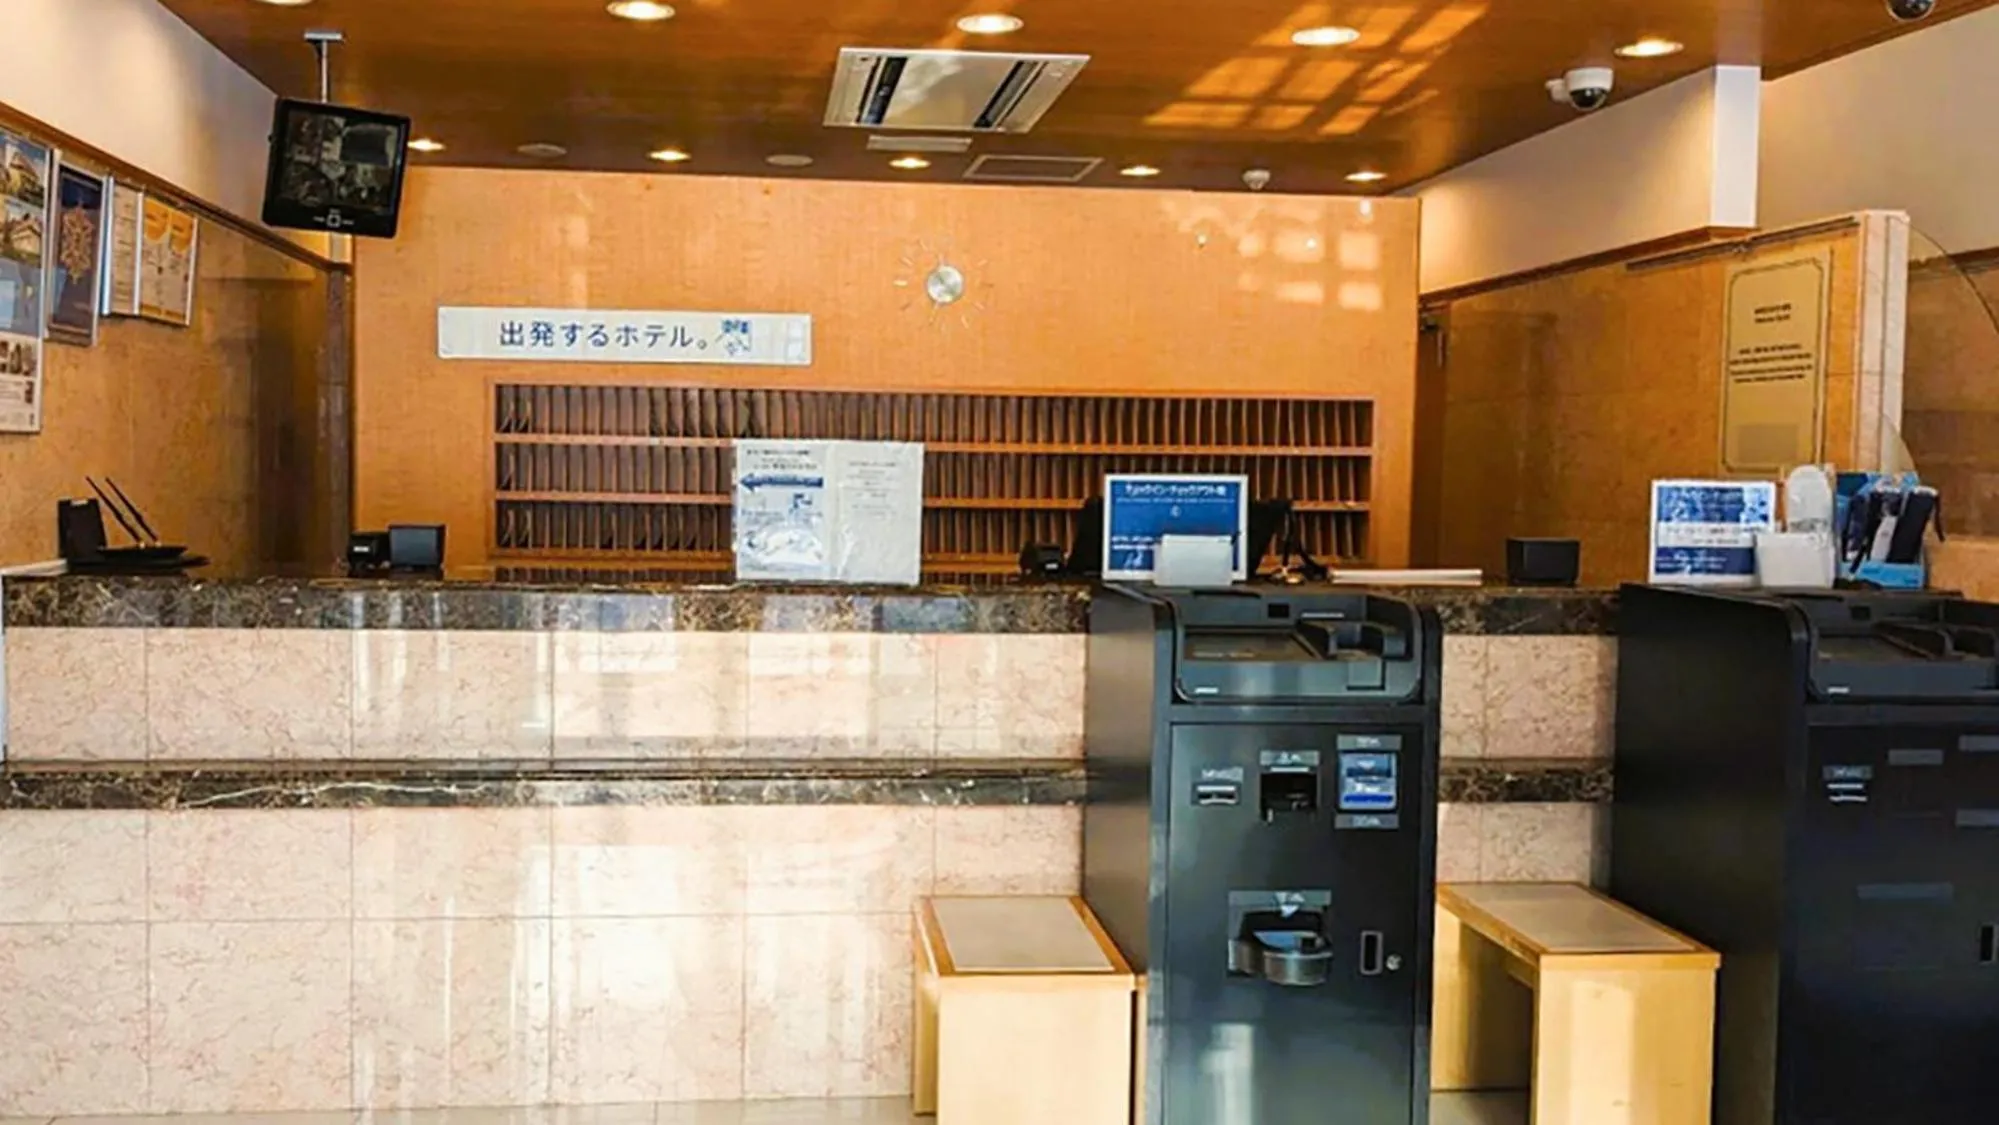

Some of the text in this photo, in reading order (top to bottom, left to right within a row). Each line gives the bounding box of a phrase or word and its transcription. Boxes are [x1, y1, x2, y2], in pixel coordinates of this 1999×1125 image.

[500, 320, 708, 350] 出発するホテル。
